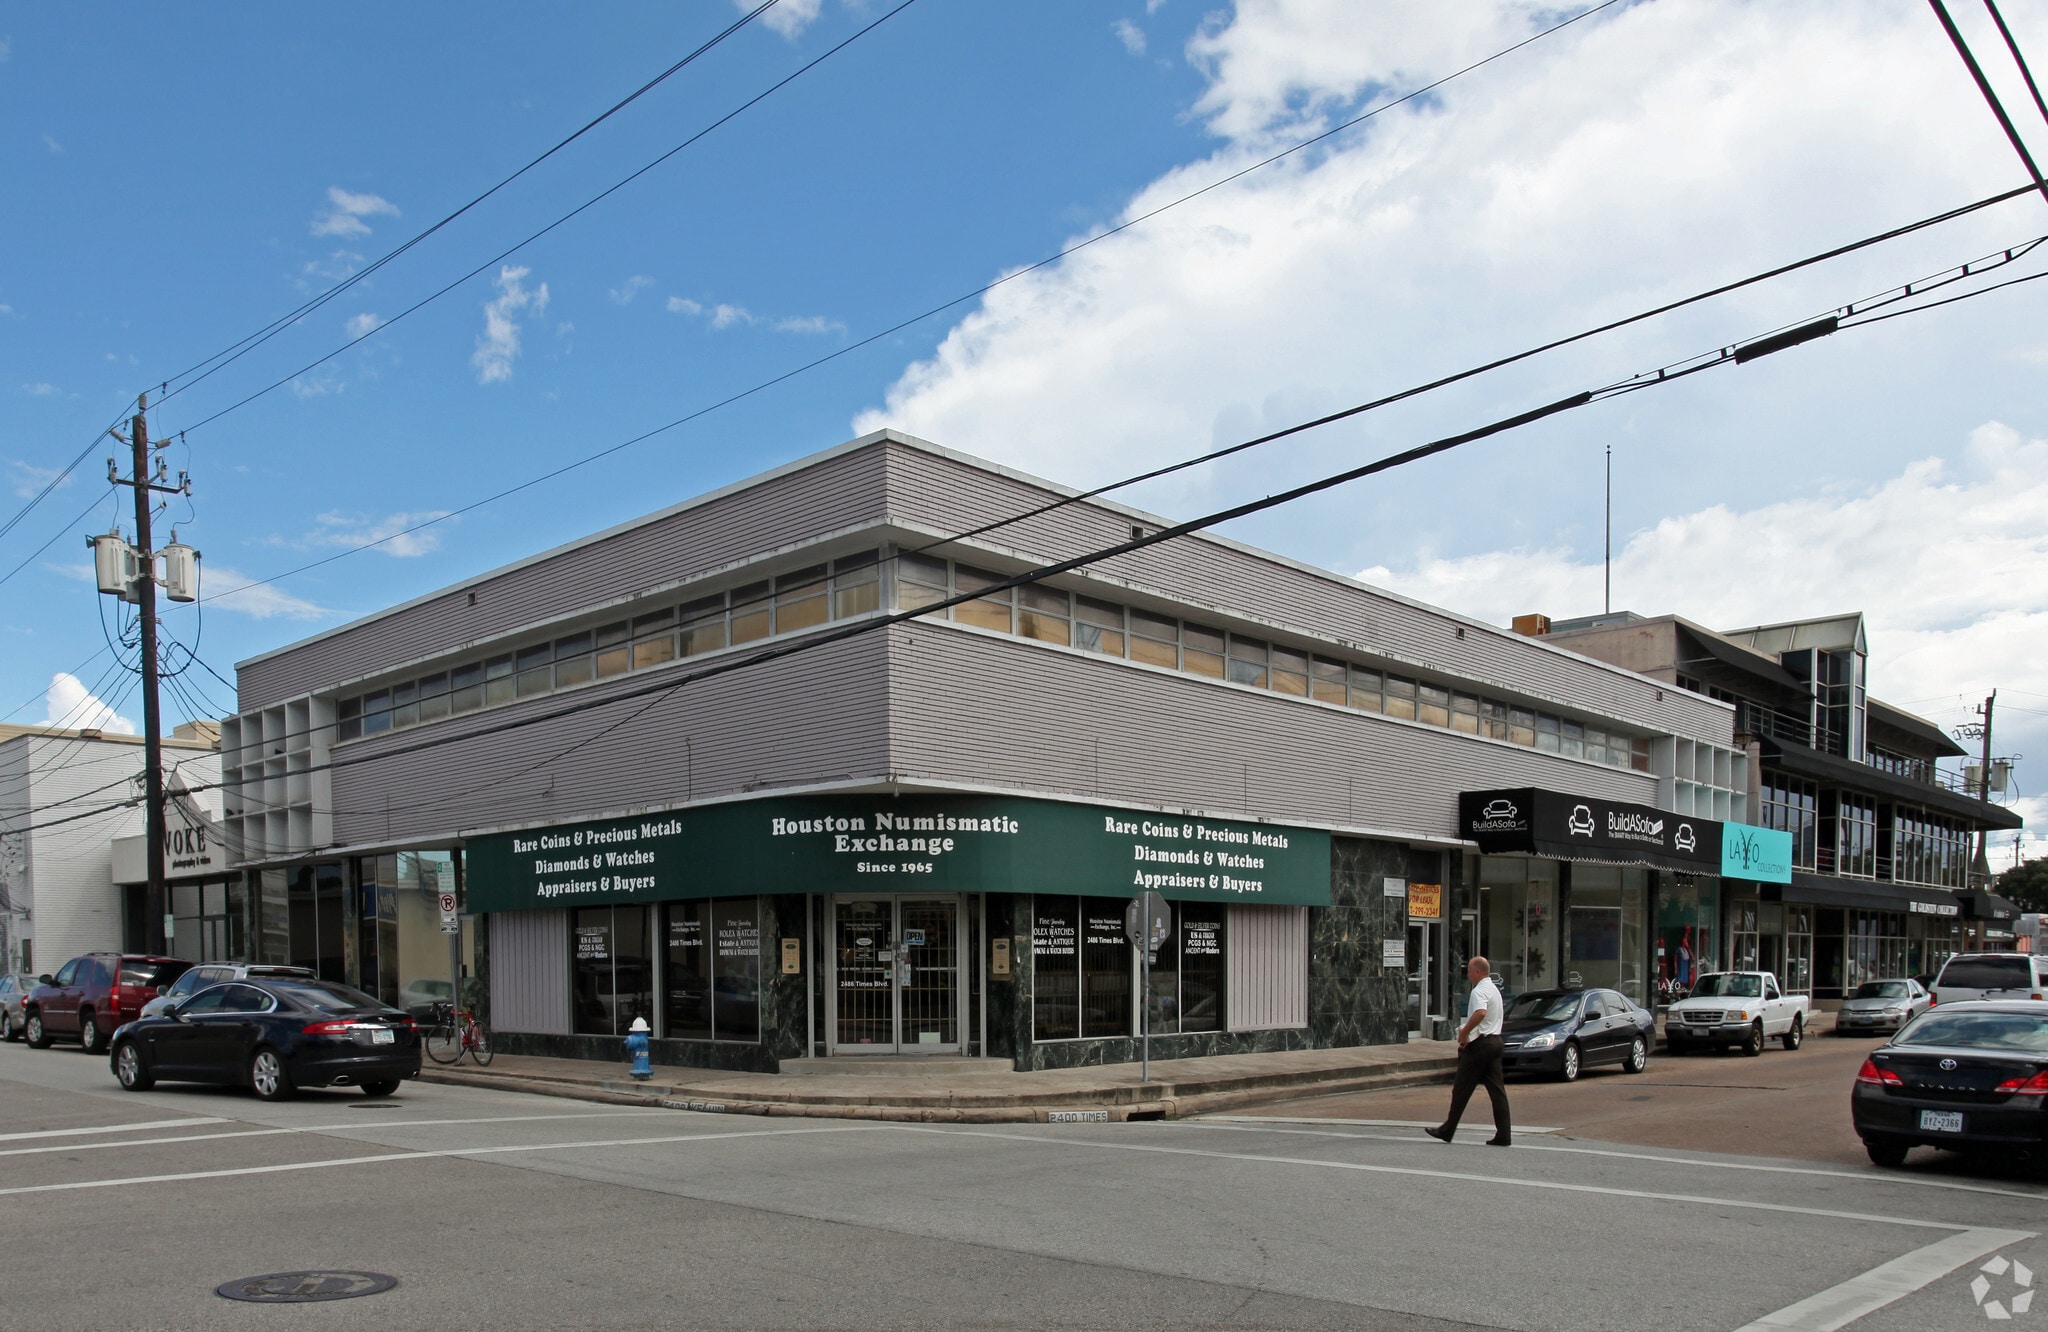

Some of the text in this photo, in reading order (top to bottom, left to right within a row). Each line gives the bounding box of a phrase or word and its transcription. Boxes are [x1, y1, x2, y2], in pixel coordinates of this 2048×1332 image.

[772, 812, 1018, 836] Houston Numismatic
[1105, 816, 1288, 848] Rare Coins & Precious Metals
[1473, 820, 1516, 829] BuildASofa
[1608, 811, 1654, 835] BuildASofa
[514, 819, 682, 853] Rare Coins & Precious Metals
[834, 834, 954, 856] Exchange
[535, 850, 655, 874] Diamonds & Watches
[857, 862, 933, 874] Since 1965
[1134, 845, 1264, 869] Diamonds & Watches
[537, 876, 655, 898] Appraisers & Buyers
[1134, 870, 1262, 893] Appraisers & Buyers
[906, 932, 923, 940] OPEN
[1918, 1083, 1976, 1091] AVALON
[1051, 1112, 1107, 1123] 2400 TIMES
